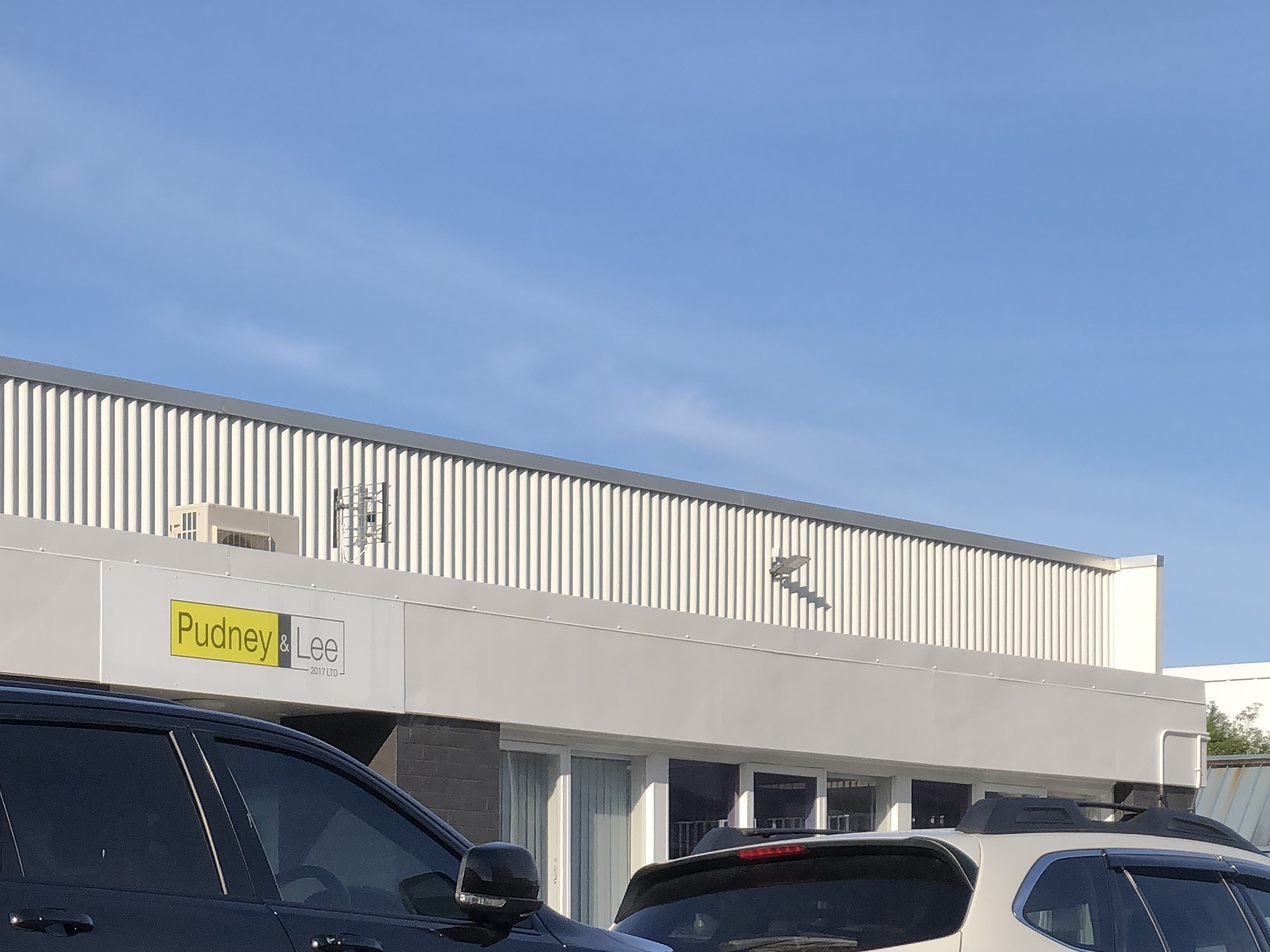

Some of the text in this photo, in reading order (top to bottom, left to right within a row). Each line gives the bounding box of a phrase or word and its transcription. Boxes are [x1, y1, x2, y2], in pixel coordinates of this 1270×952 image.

[178, 611, 338, 663] Pudney & Lee
[310, 666, 339, 677] 2017 LTD
